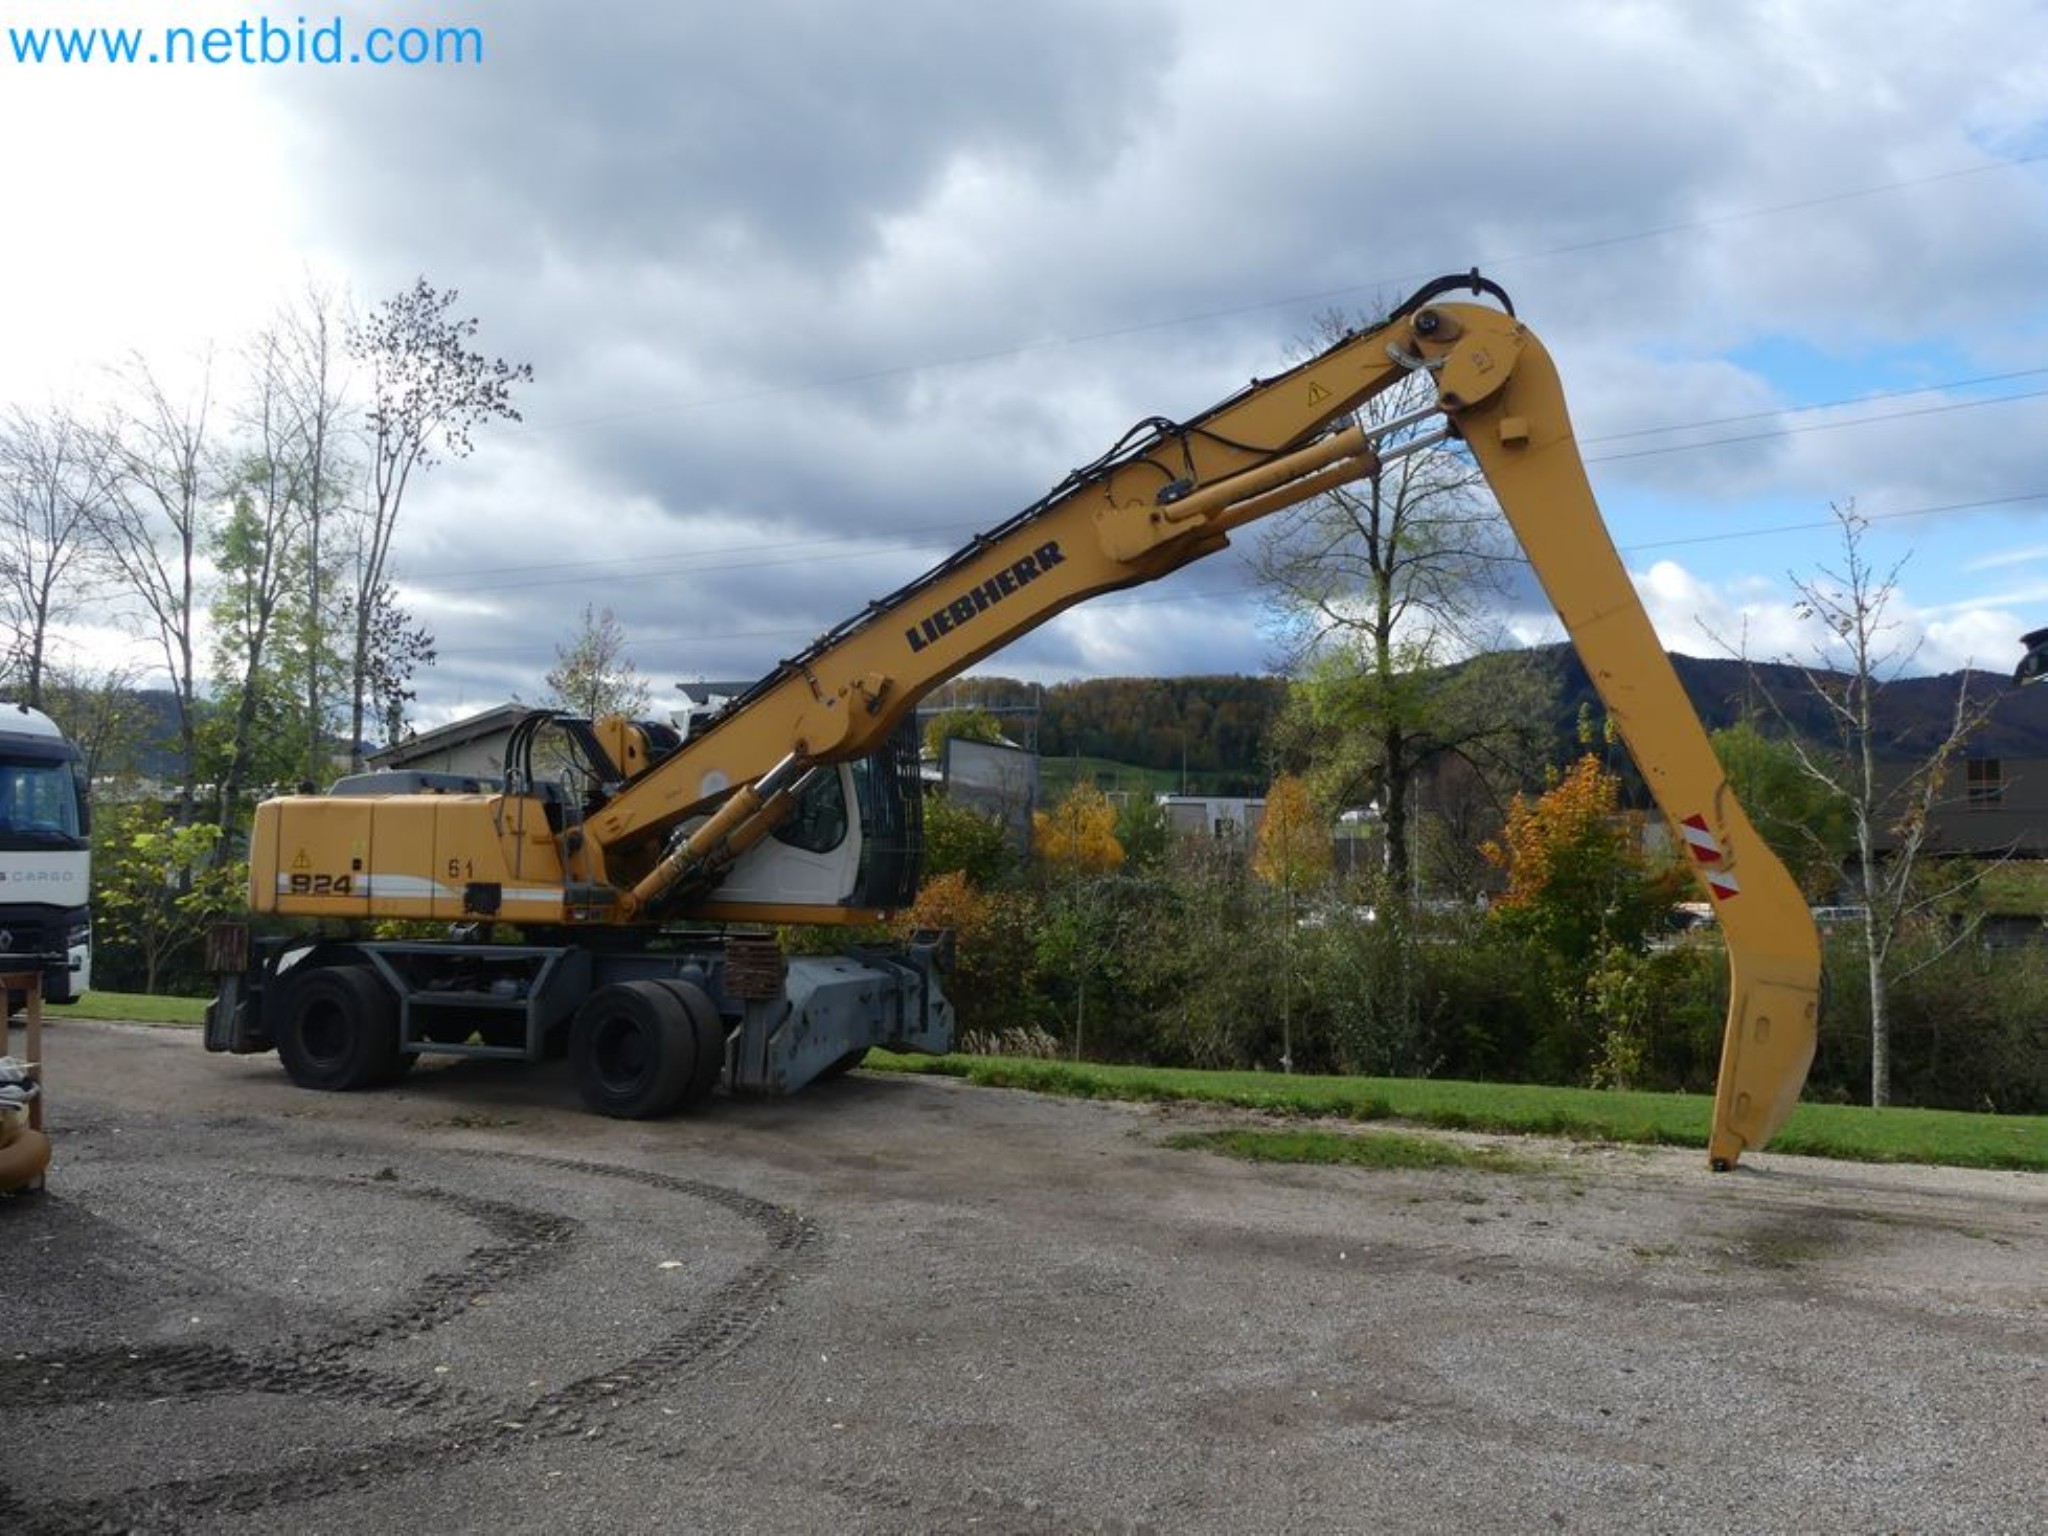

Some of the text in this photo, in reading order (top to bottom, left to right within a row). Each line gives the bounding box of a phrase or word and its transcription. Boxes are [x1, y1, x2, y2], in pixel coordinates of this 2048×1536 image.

[905, 541, 1067, 653] LIEBHERR
[12, 871, 73, 882] CARGO
[449, 858, 473, 880] 61
[291, 873, 352, 894] 924
